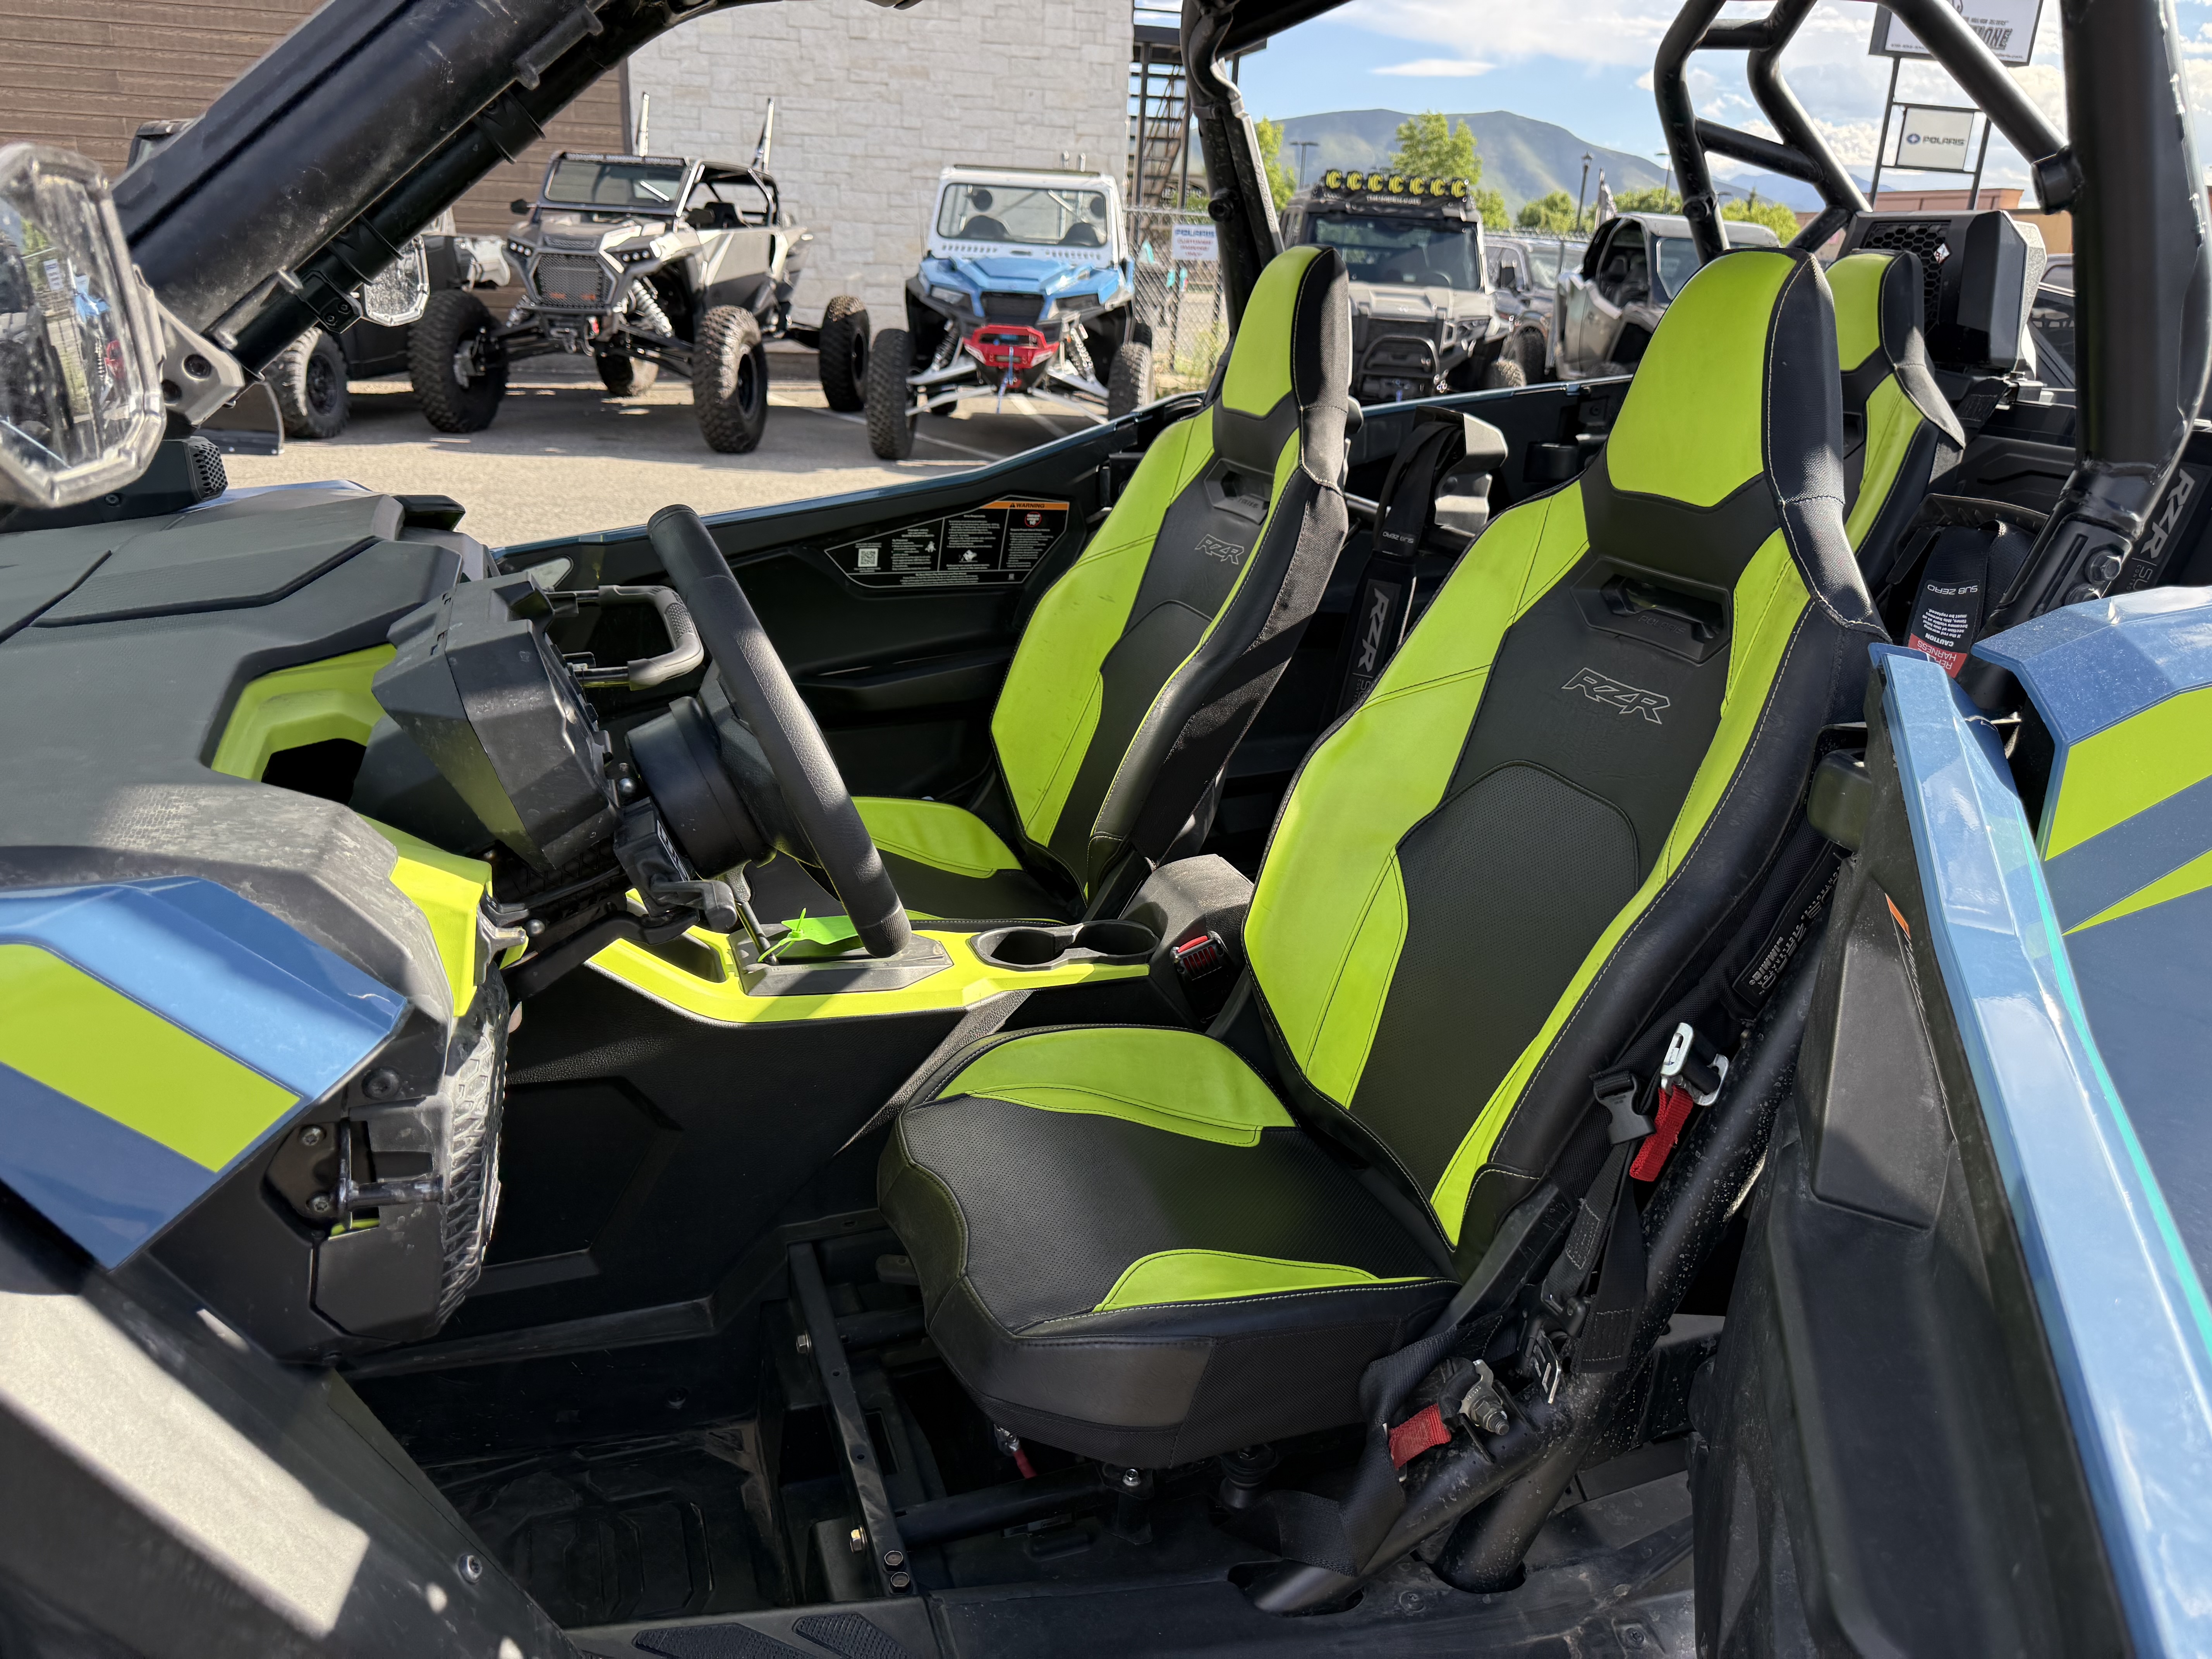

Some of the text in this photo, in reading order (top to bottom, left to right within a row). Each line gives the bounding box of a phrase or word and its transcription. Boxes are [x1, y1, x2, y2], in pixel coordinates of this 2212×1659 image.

[1922, 135, 1965, 146] POLARIS
[2140, 468, 2195, 559] RZR
[1382, 531, 1399, 540] ZERO
[1195, 534, 1244, 565] RZR
[2126, 565, 2142, 591] CONTRO
[2133, 566, 2153, 591] SU
[1927, 584, 1978, 595] SUB ZERO
[1926, 612, 1943, 621] harness
[1928, 608, 1948, 617] replaced.
[1358, 588, 1389, 672] RZR
[1638, 616, 1686, 635] POLARIS
[1923, 624, 1940, 634] warning
[1925, 633, 1954, 647] CAUTION
[1917, 640, 1957, 661] HARNESS
[1561, 667, 1670, 724] RZR
